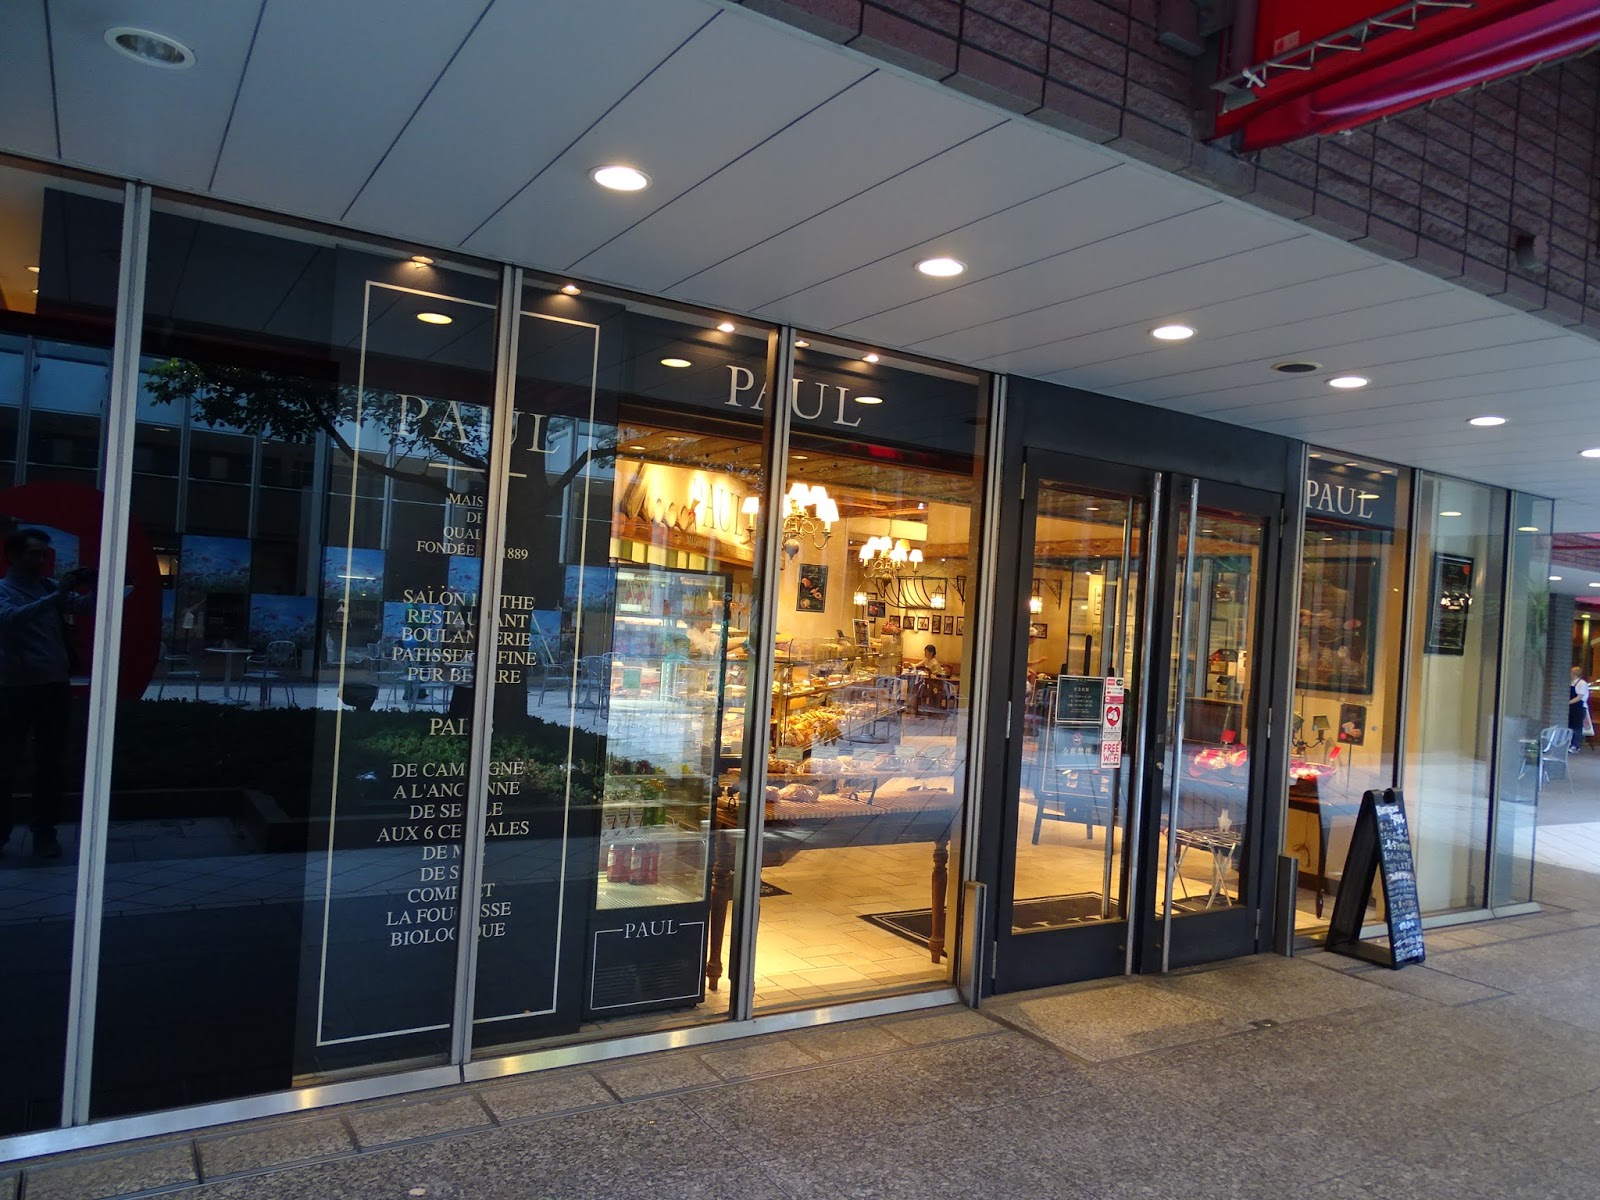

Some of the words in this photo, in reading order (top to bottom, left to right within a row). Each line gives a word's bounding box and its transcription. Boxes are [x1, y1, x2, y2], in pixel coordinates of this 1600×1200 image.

[393, 393, 561, 454] PAUL
[1305, 479, 1373, 519] PAUL
[416, 540, 476, 556] FONDÉE
[403, 589, 466, 607] SALON
[500, 594, 535, 610] THE
[407, 608, 529, 629] RESTAUNT
[401, 626, 532, 647] BOULANERIE
[497, 650, 537, 666] FINE
[408, 667, 444, 682] PUR
[450, 667, 521, 684] BERE
[1103, 743, 1120, 753] FREE
[1103, 753, 1120, 762] Wi-Fi
[391, 763, 418, 778] DE
[422, 761, 524, 778] CAMGNE
[393, 784, 408, 799] A
[411, 781, 521, 799] L'ANCNNE
[409, 804, 436, 820] DE
[376, 825, 419, 842] AUX
[424, 824, 434, 840] 6
[437, 820, 530, 839] CEALES
[422, 845, 448, 861] DE
[420, 866, 446, 882] DE
[407, 882, 496, 904] COMPT
[386, 910, 412, 926] LA
[416, 901, 512, 924] FOUSSE
[389, 922, 507, 947] BIOLOUE
[624, 919, 679, 939] PAUL
